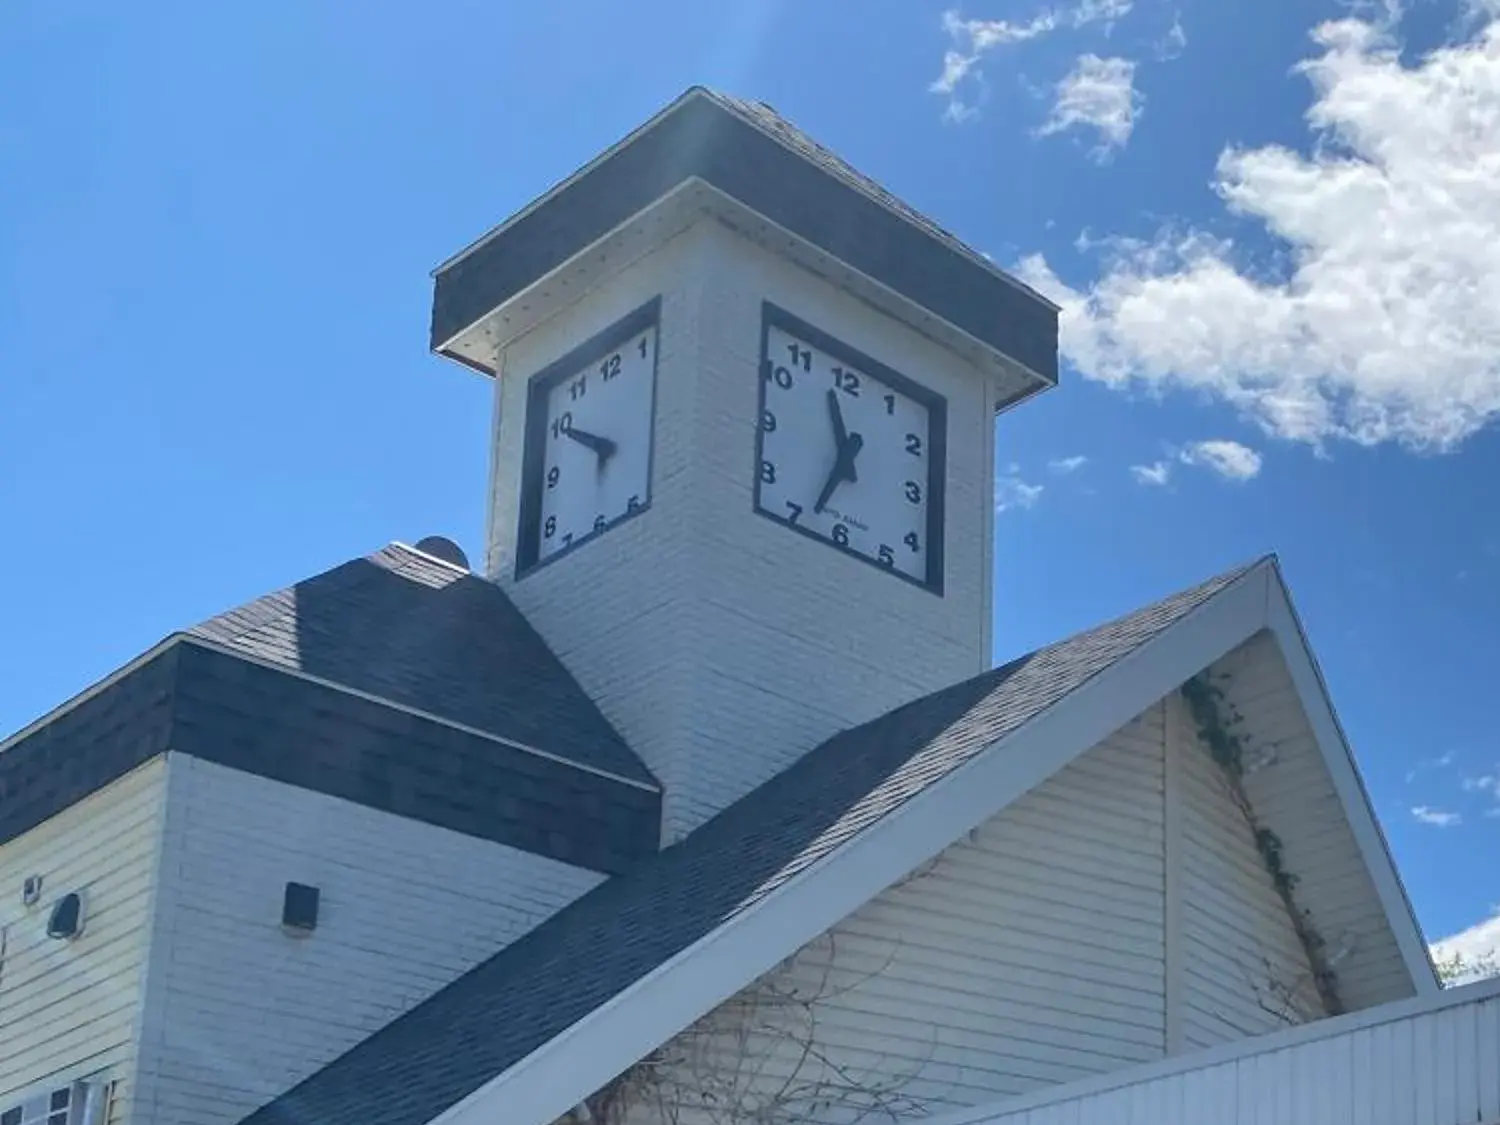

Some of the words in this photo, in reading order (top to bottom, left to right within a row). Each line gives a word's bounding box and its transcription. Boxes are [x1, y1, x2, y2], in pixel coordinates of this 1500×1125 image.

[637, 336, 647, 359] 1
[786, 344, 812, 373] 11
[600, 353, 622, 382] 12
[763, 360, 793, 391] 10
[568, 373, 587, 401] 11
[831, 366, 861, 398] 12
[883, 394, 895, 416] 1
[552, 410, 573, 440] 10
[761, 410, 777, 433] 9
[905, 433, 921, 457] 2
[547, 465, 561, 489] 9
[760, 460, 776, 485] 8
[905, 481, 921, 505] 3
[785, 501, 803, 526] 7
[545, 515, 557, 539] 8
[831, 523, 849, 547] 6
[904, 531, 920, 553] 4
[879, 544, 895, 568] 5
